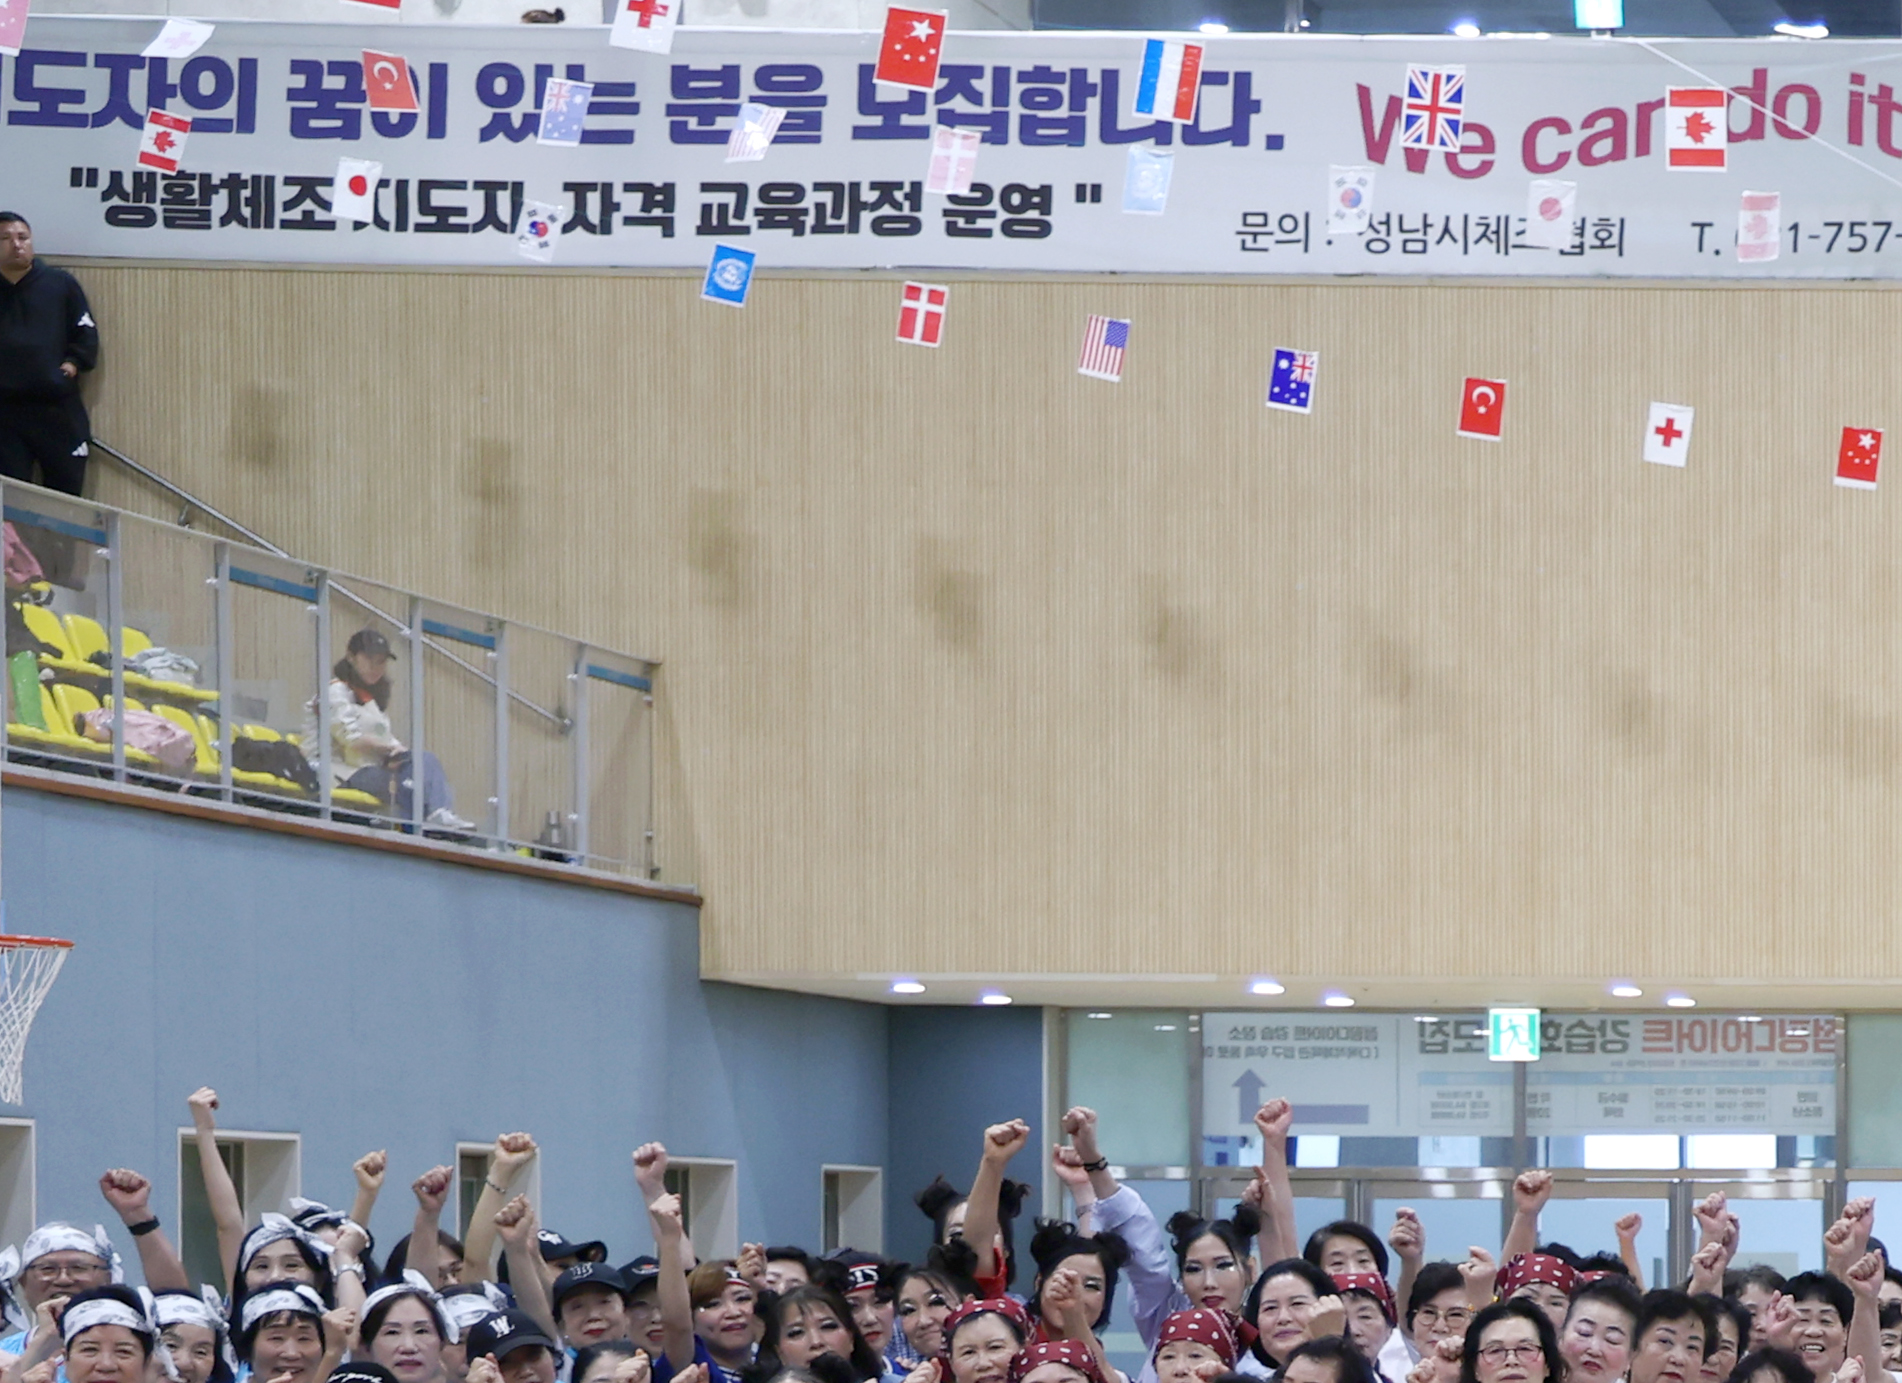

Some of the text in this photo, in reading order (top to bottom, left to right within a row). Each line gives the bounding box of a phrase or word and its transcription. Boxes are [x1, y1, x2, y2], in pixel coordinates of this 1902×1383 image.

[0, 46, 258, 134] 도자의
[286, 60, 448, 141] 꿈이
[665, 63, 827, 146] 분을
[852, 64, 1285, 152] 모집합니다.
[1356, 83, 1496, 180] We
[1726, 67, 1822, 142] do
[561, 182, 676, 238] 자격
[695, 182, 922, 240] 교육과정
[941, 182, 1053, 240] 운영
[1235, 210, 1310, 254] 문의
[1690, 221, 1721, 256] T.
